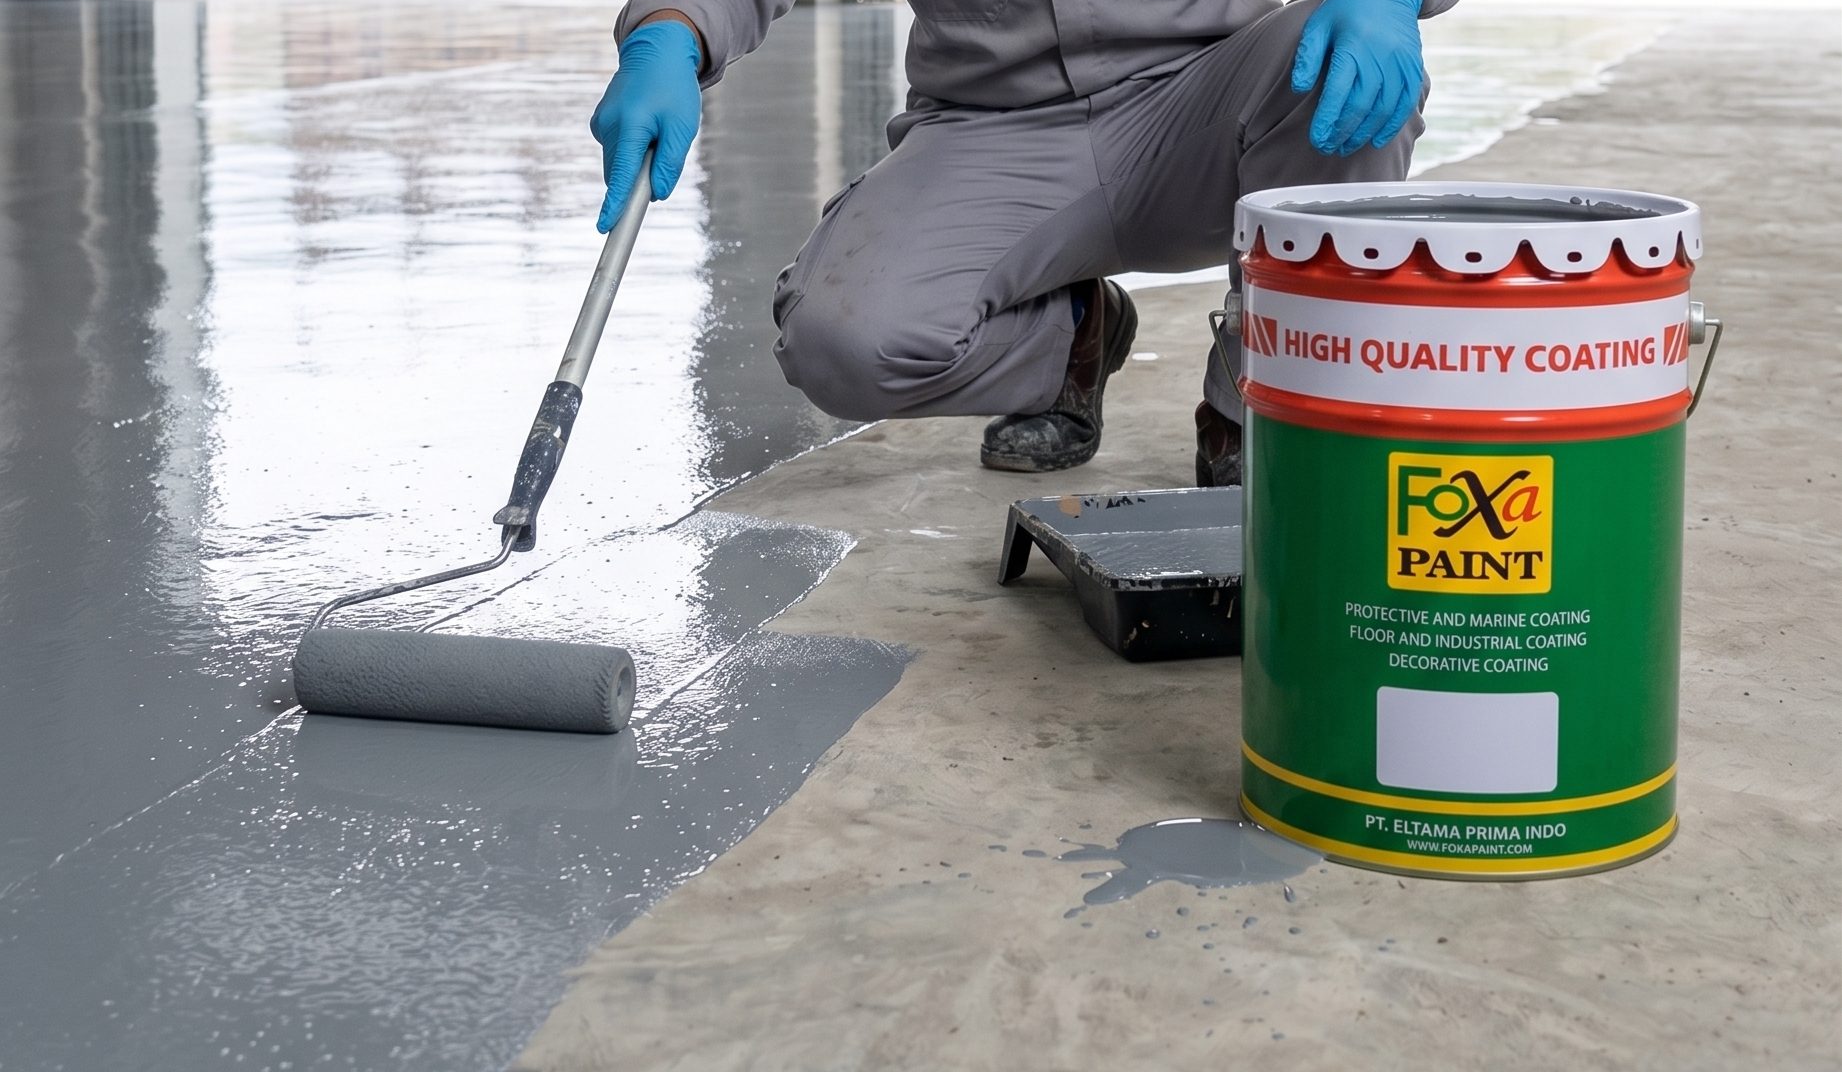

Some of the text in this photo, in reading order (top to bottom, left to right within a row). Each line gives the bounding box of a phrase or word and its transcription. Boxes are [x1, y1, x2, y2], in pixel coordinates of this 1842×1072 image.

[1285, 329, 1654, 373] HIGH QUALITY COATING
[1397, 547, 1543, 580] PAINT
[1345, 602, 1590, 627] PROTECTIVE AND MARINE COATING
[1350, 625, 1587, 650] FLOOR AND INDUSTRIAL COATING
[1389, 653, 1548, 673] DECORATIVE COATING
[1365, 814, 1566, 840] PT. ELTAMA PRIMA INDO
